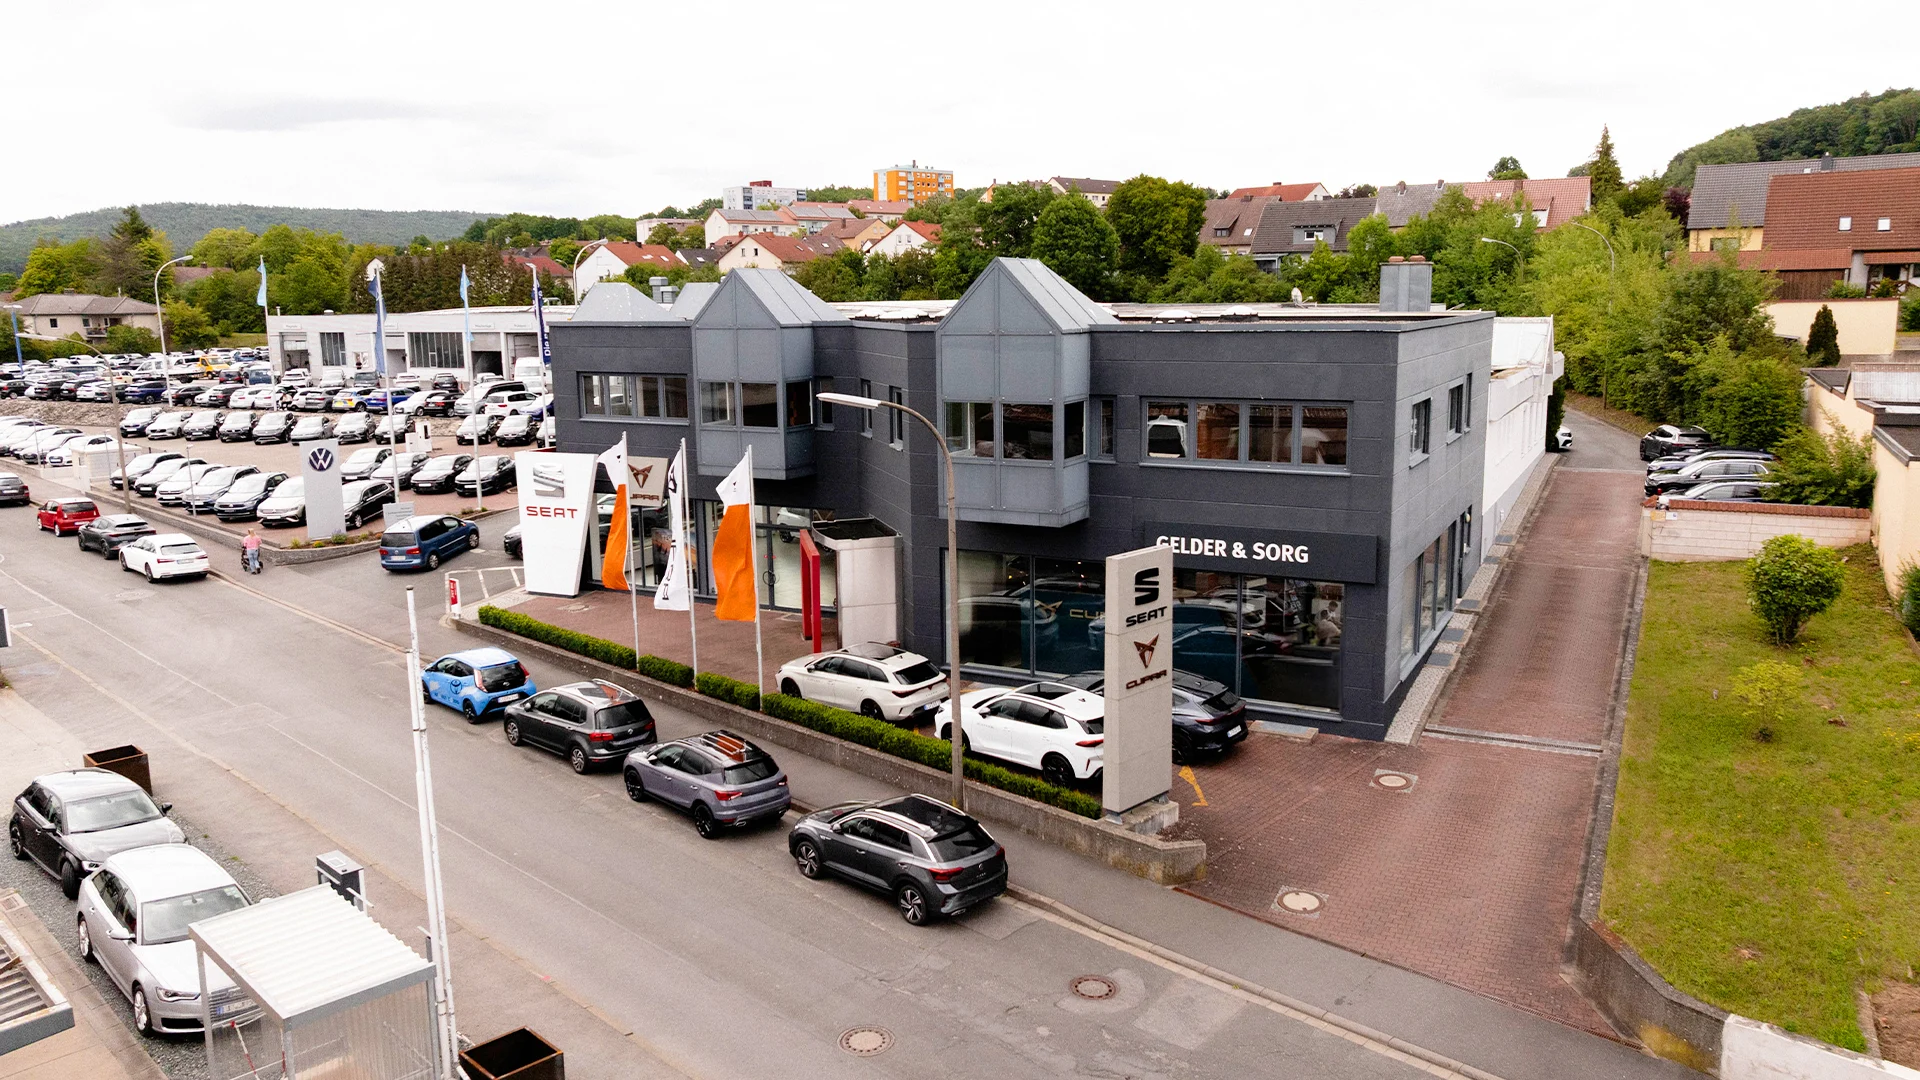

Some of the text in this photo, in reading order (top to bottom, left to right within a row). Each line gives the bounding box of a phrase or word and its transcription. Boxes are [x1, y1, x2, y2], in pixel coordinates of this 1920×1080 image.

[630, 493, 659, 501] UPRA
[526, 506, 578, 518] SEAT
[1156, 535, 1309, 563] GELDER & SORG
[1125, 606, 1168, 627] SEAT
[1125, 669, 1167, 689] CUPRA
